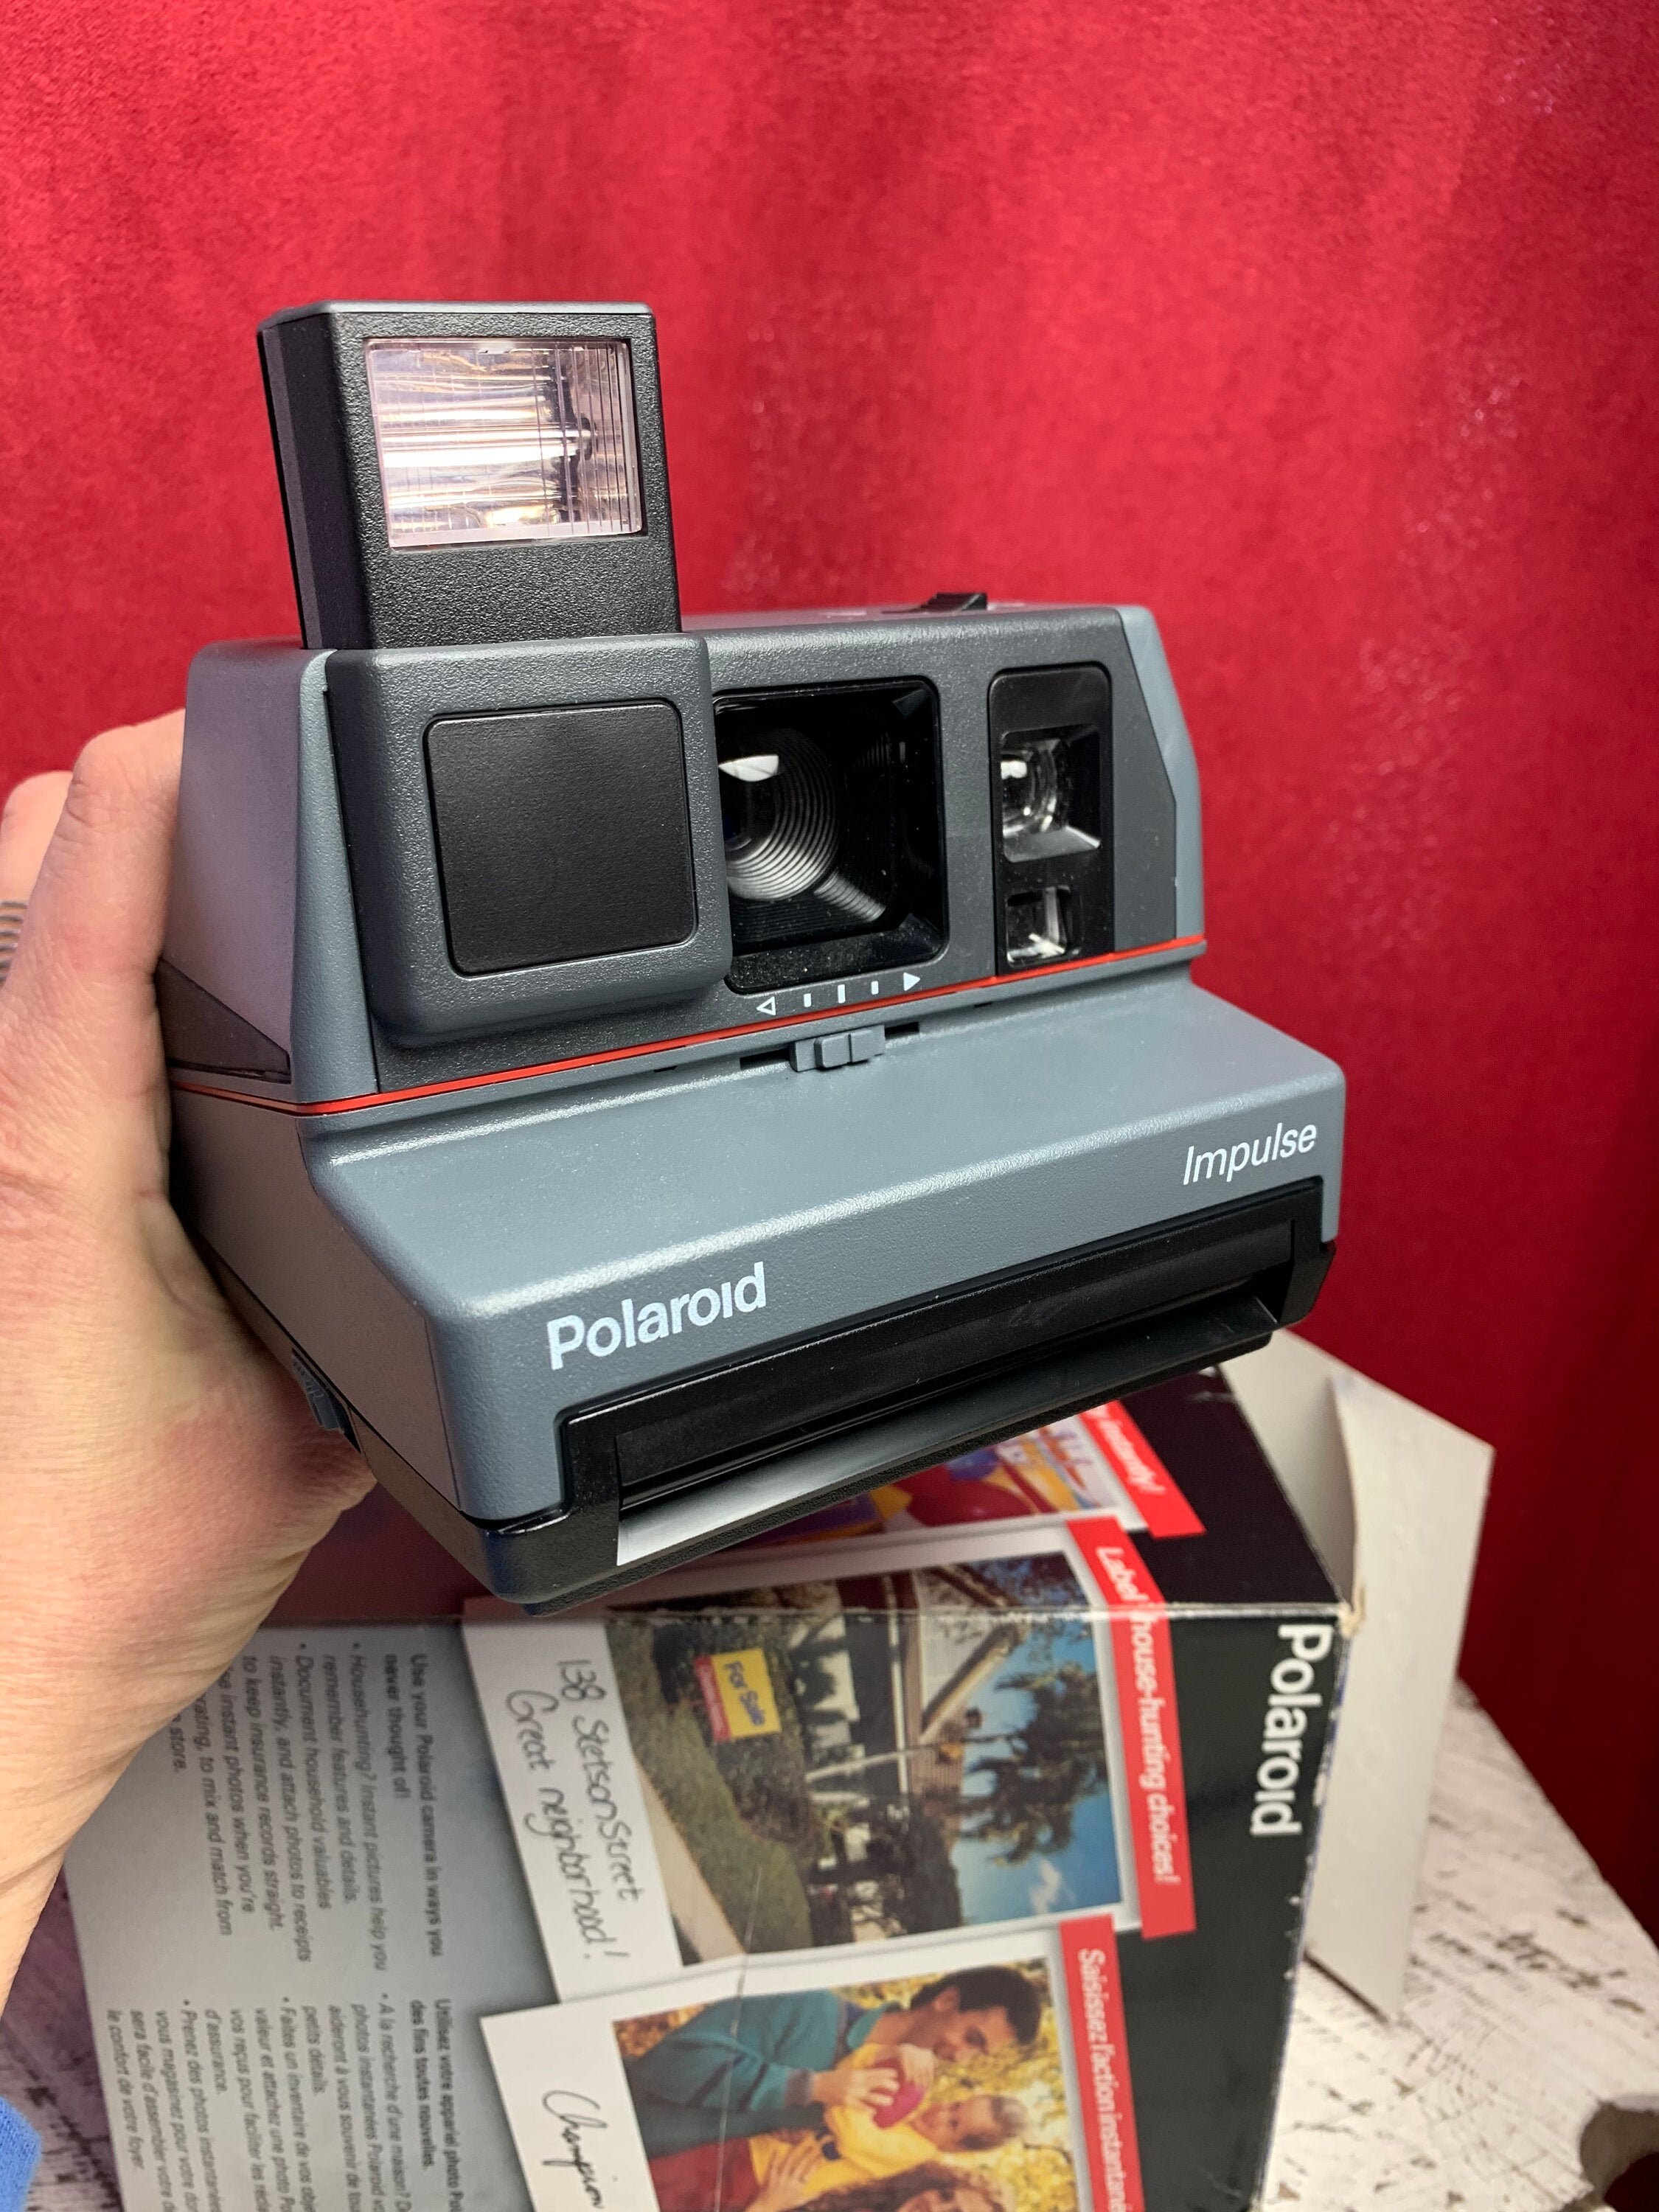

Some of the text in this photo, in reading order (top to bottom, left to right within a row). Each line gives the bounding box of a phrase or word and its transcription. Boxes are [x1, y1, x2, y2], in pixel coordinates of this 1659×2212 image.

[1183, 1123, 1317, 1186] Impulse
[546, 1261, 767, 1370] Polaroid
[242, 1655, 260, 1674] to
[383, 1654, 402, 1701] never
[220, 1693, 241, 1753] instant
[243, 1678, 266, 1718] keep
[322, 1655, 345, 1742] remember
[1095, 1547, 1181, 1885] Label house-hunting choices!
[276, 1737, 297, 1769] and
[386, 1707, 410, 1773] thought
[504, 1689, 560, 1773] Great
[1249, 1624, 1334, 1836] Polaroid
[198, 1756, 216, 1774] to
[223, 1755, 248, 1813] photos
[248, 1722, 272, 1803] insurance
[294, 1655, 334, 1911] Document household valuables
[332, 1747, 352, 1814] features
[554, 1658, 646, 1903] 138 Stetson Street
[202, 1778, 223, 1808] mix
[279, 1773, 299, 1823] attach
[410, 1653, 445, 1958] Use your Polaroid camera in ways you
[206, 1812, 226, 1843] and
[232, 1817, 254, 1861] when
[257, 1806, 279, 1866] records
[283, 1826, 305, 1880] photos
[335, 1816, 356, 1847] and
[209, 1846, 232, 1895] match
[234, 1864, 257, 1913] you're
[291, 1884, 307, 1901] to
[362, 1842, 386, 1904] pictures
[215, 1898, 235, 1936] from
[293, 1903, 314, 1963] receipts
[369, 1907, 389, 1940] help
[369, 1943, 389, 1972] you
[1077, 1947, 1109, 2043] Saisissez
